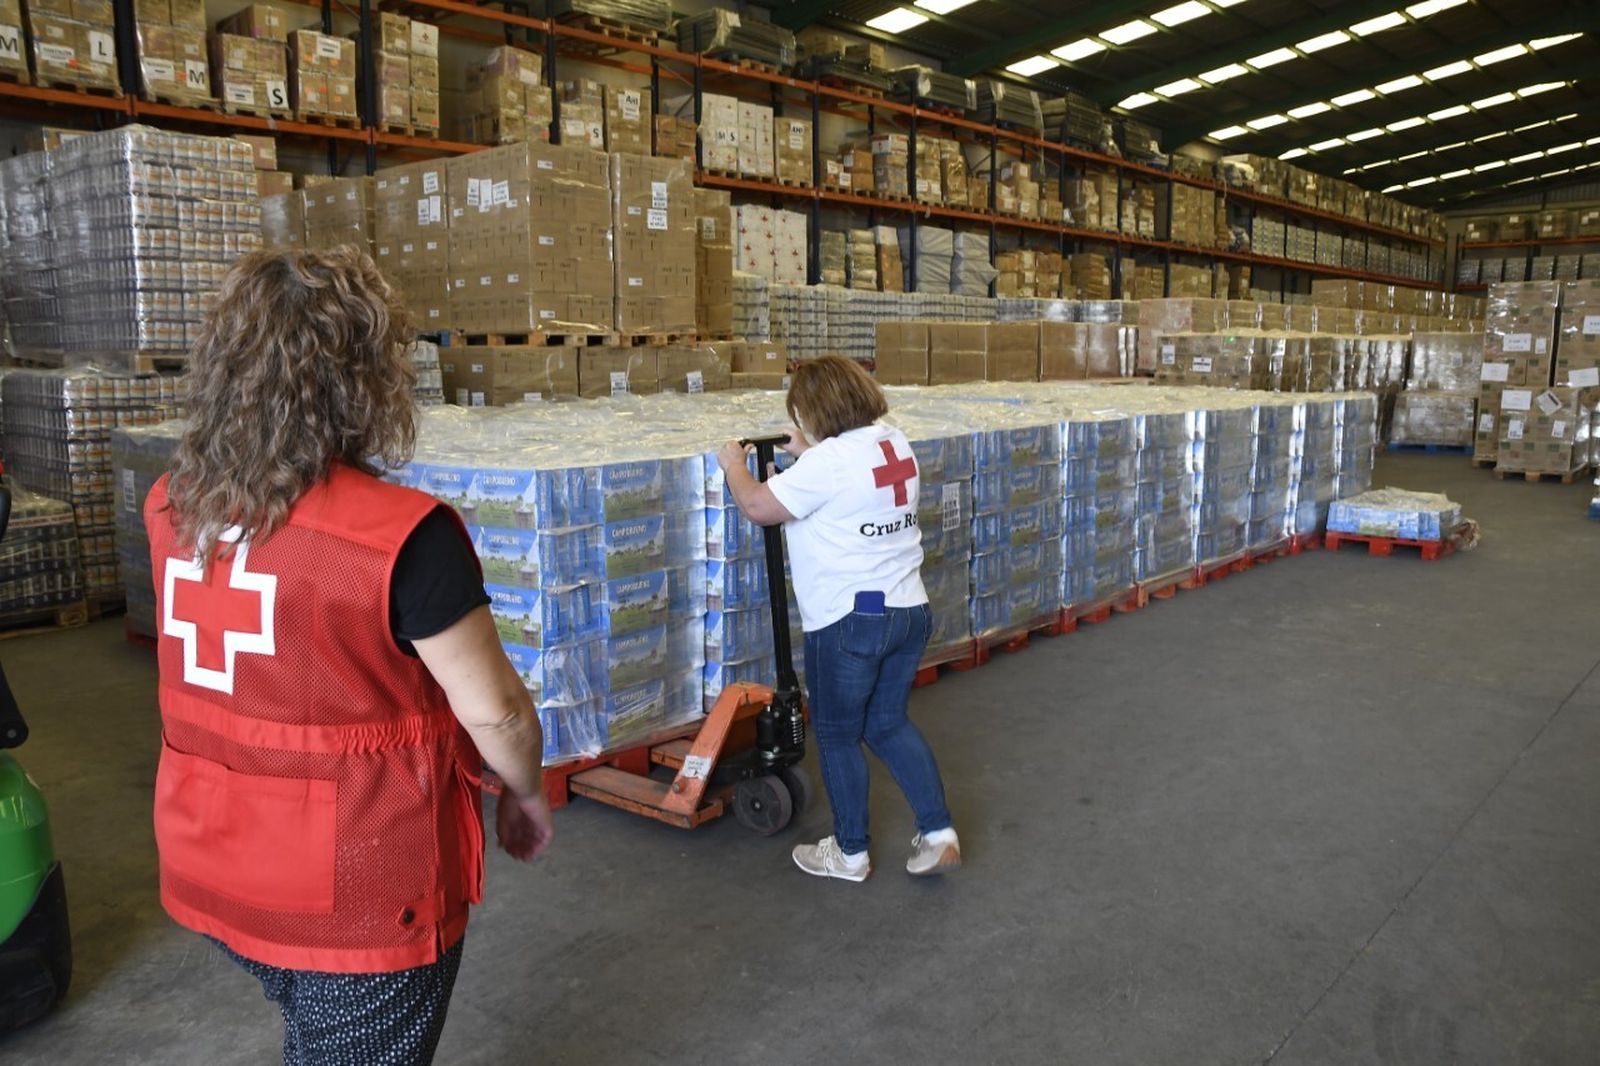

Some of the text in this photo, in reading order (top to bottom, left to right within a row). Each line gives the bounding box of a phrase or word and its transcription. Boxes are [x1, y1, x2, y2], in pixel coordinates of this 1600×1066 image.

[98, 40, 107, 56] L
[189, 69, 205, 84] M
[272, 88, 283, 105] S
[593, 127, 600, 138] S
[859, 520, 901, 537] Cruz
